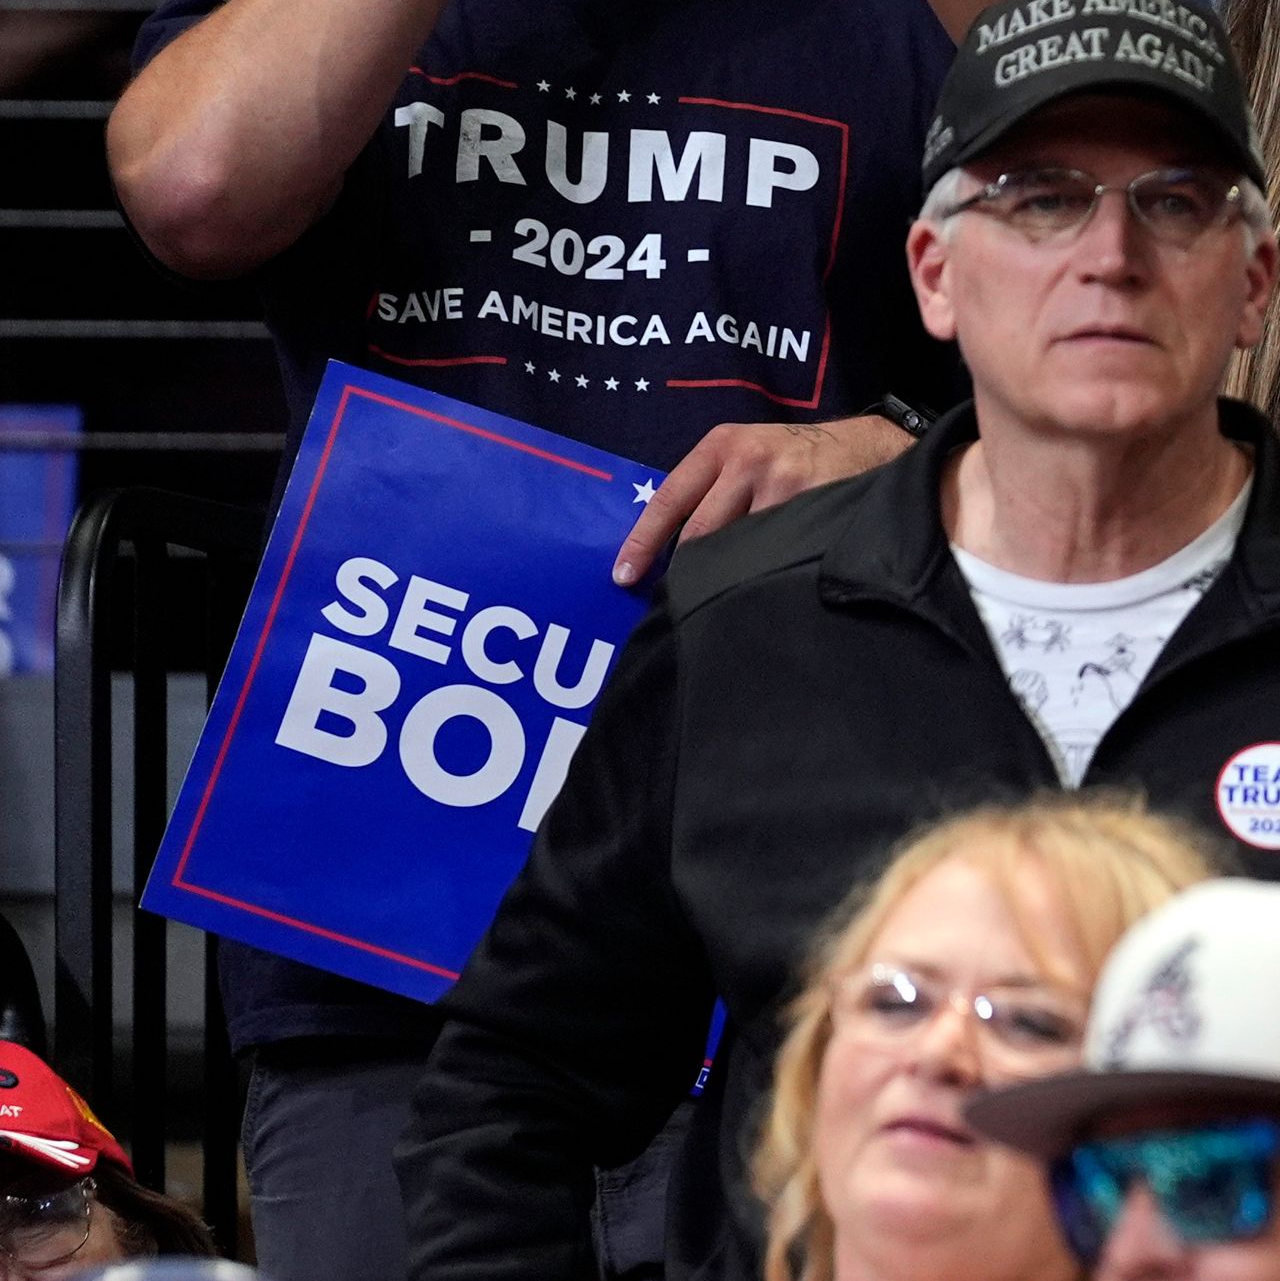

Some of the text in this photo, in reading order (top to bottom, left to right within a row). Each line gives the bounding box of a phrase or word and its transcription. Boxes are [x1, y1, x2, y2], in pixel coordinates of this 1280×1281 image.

[994, 26, 1111, 88] GREAT
[394, 100, 821, 209] TRUMP
[512, 218, 666, 282] 2024
[376, 287, 812, 364] SAVE AMERICA AGAIN
[321, 556, 616, 712] SECU
